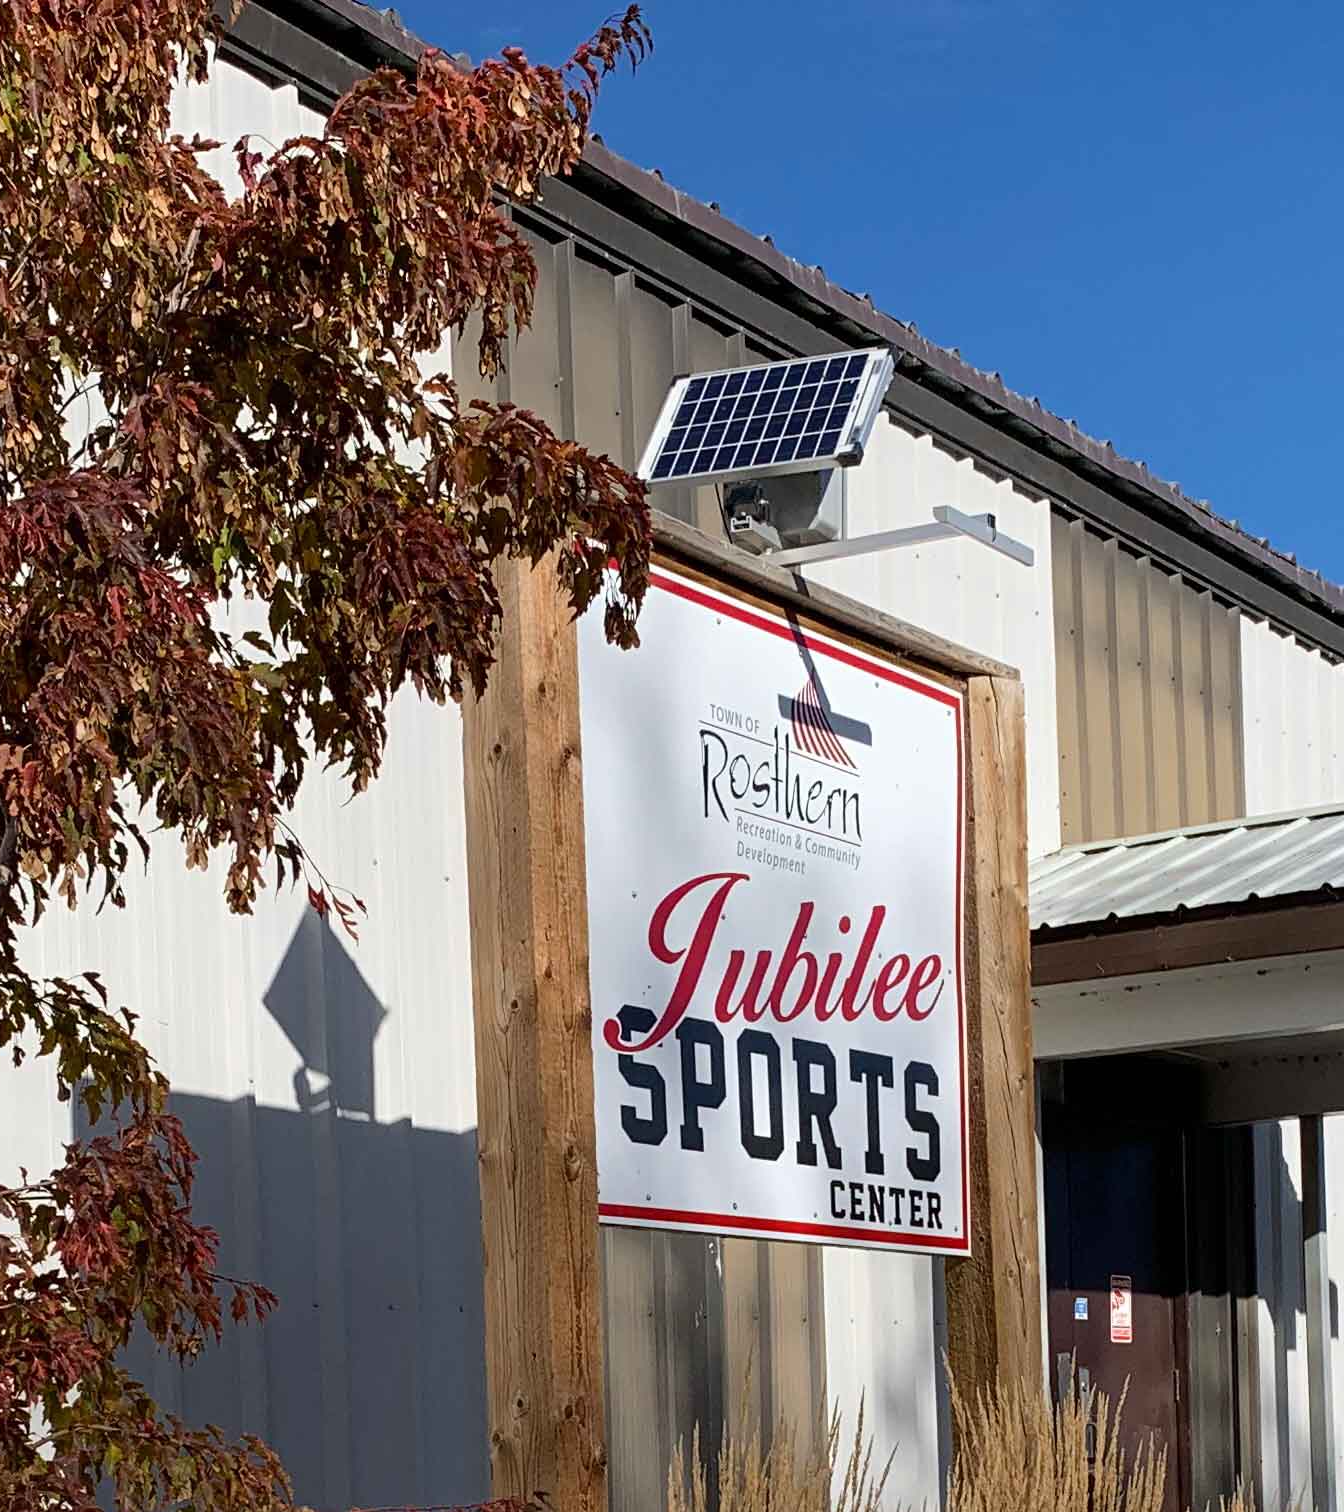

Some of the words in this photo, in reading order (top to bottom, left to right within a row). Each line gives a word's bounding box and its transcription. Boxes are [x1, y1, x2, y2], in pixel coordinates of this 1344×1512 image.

[710, 703, 743, 729] TOWN
[745, 717, 760, 734] OF
[699, 725, 863, 841] Rosthern
[736, 816, 792, 848] Recreation
[794, 833, 802, 850] &
[805, 837, 861, 870] Community
[736, 840, 806, 874] Development
[603, 872, 944, 1053] Jubilee
[616, 1004, 941, 1182] SPORTS
[830, 1180, 943, 1229] CENTER
